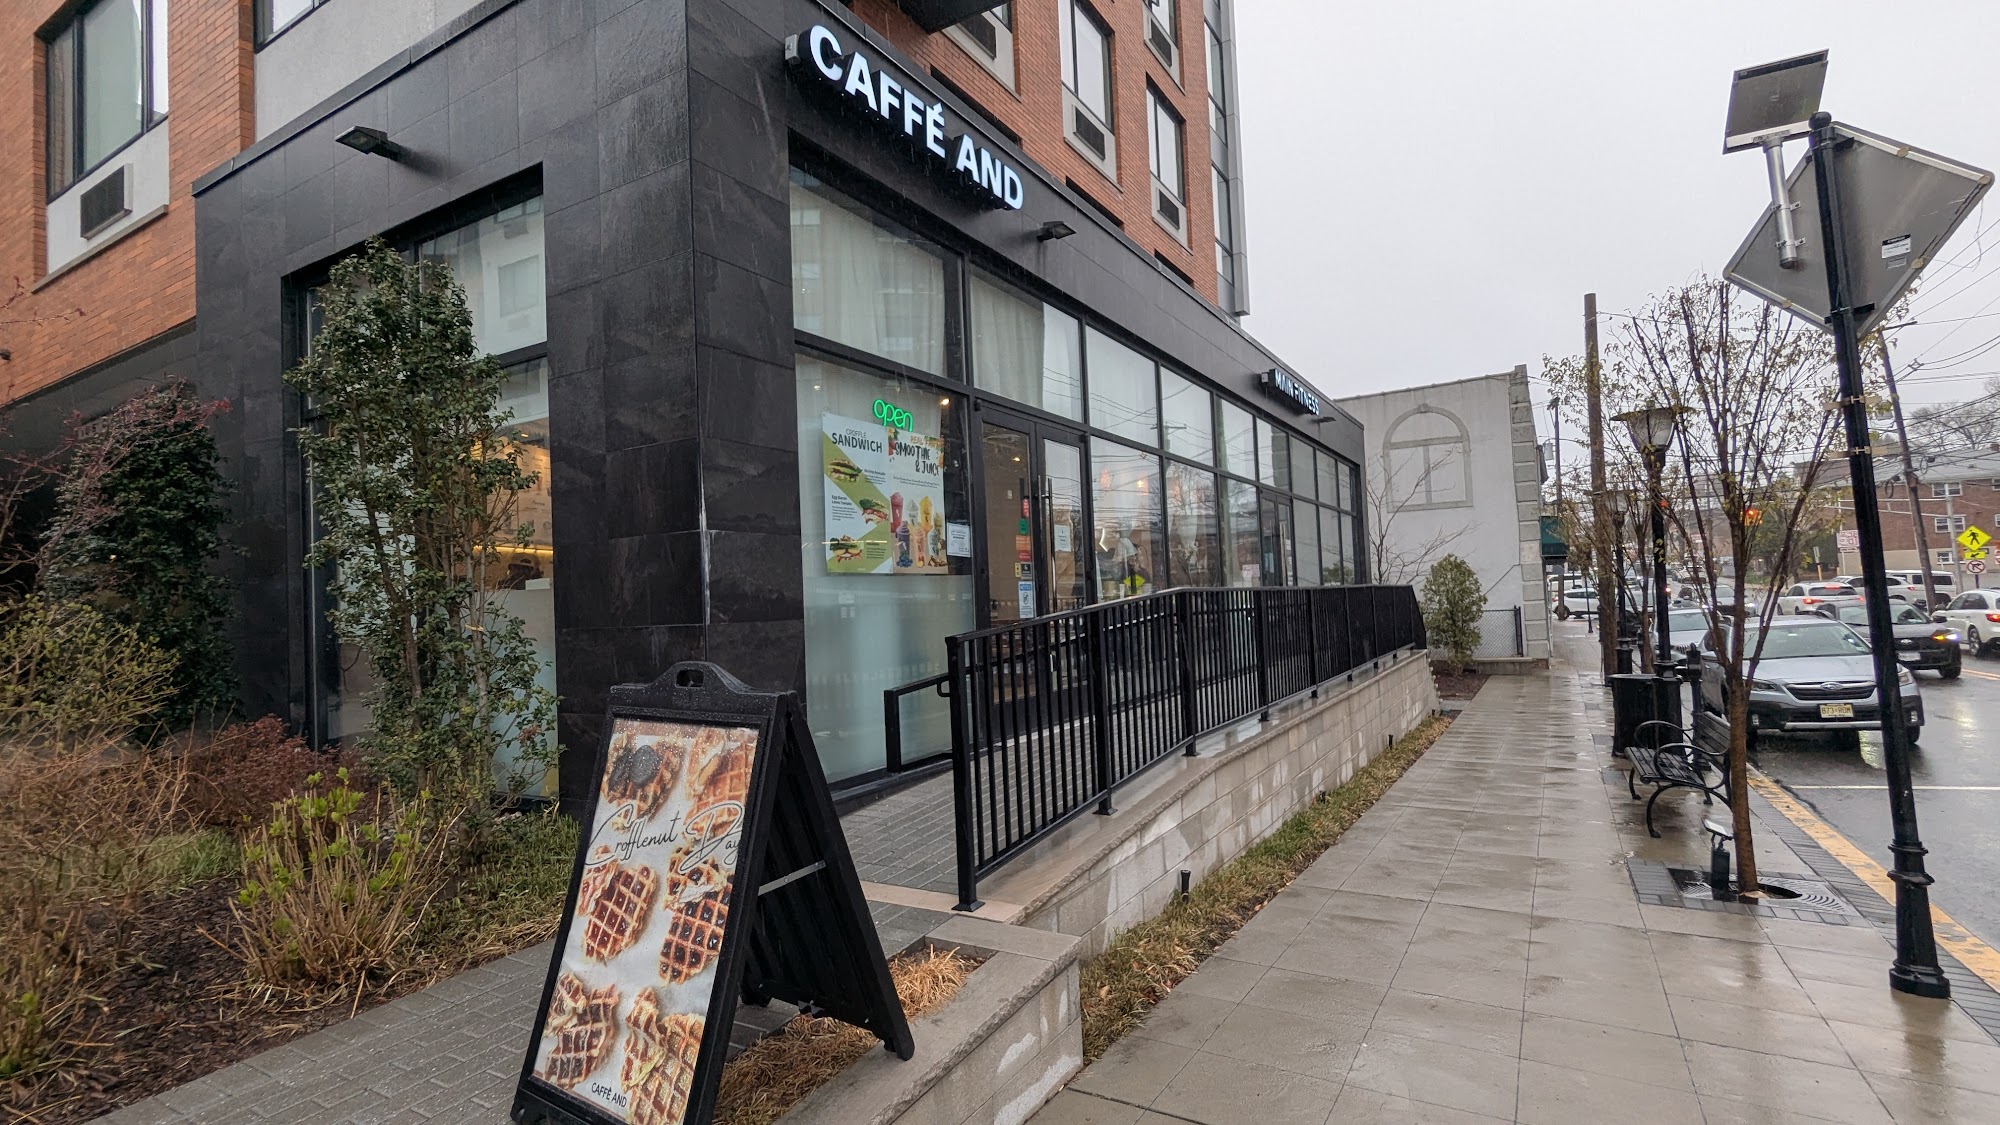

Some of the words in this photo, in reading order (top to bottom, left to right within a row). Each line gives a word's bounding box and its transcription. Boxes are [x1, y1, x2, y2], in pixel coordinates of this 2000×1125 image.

[810, 25, 946, 158] CAFFÉ
[956, 134, 1024, 210] AND
[1293, 382, 1319, 416] FITNESS
[873, 399, 913, 432] open
[831, 432, 883, 453] SANDWICH
[895, 441, 931, 461] SMOOTHIE
[915, 460, 921, 472] &
[921, 460, 940, 476] JUICE
[585, 803, 682, 866] Crofflenut
[591, 1082, 612, 1101] CAFFÉ
[611, 1092, 627, 1108] AND
